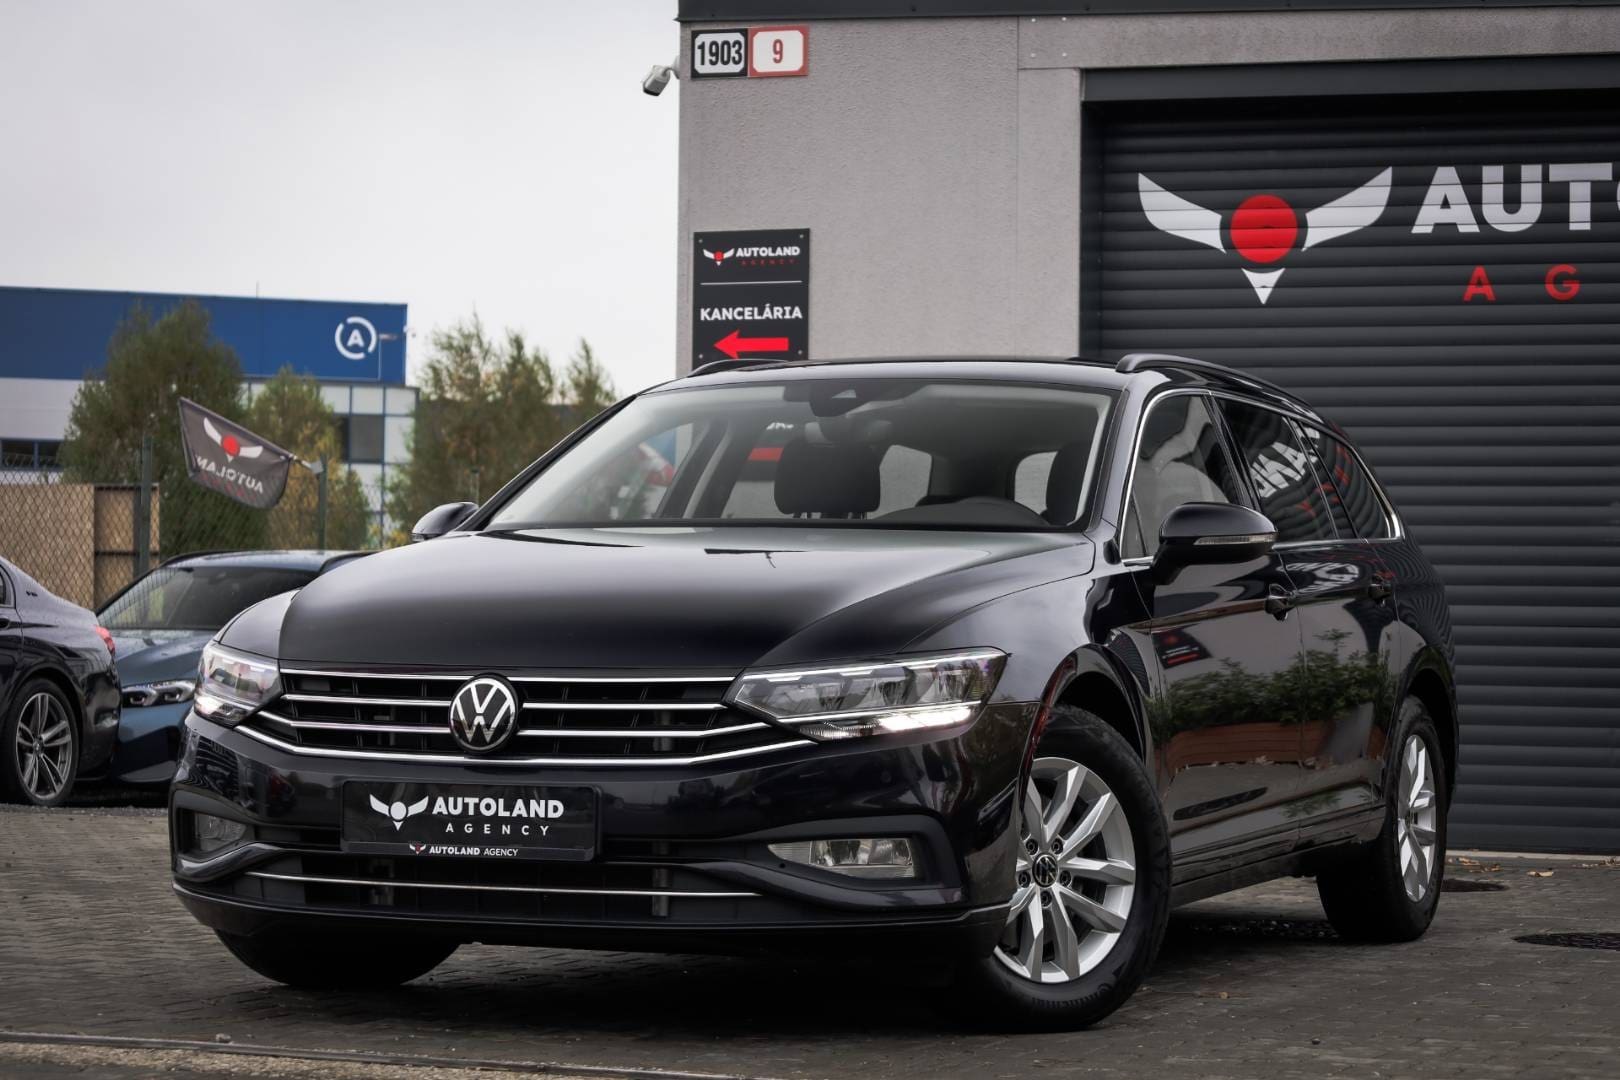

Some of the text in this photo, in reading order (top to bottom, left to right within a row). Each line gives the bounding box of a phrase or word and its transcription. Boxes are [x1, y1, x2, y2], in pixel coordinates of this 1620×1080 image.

[697, 40, 742, 66] 1903
[772, 38, 784, 64] 9
[1411, 162, 1620, 233] AUT
[736, 246, 801, 257] AUTOLAND
[700, 303, 803, 321] KANCELÁRIA
[432, 796, 565, 818] AUTOLAND
[445, 822, 550, 836] AGENCY
[429, 846, 519, 857] AUTOLAND AGENCY
